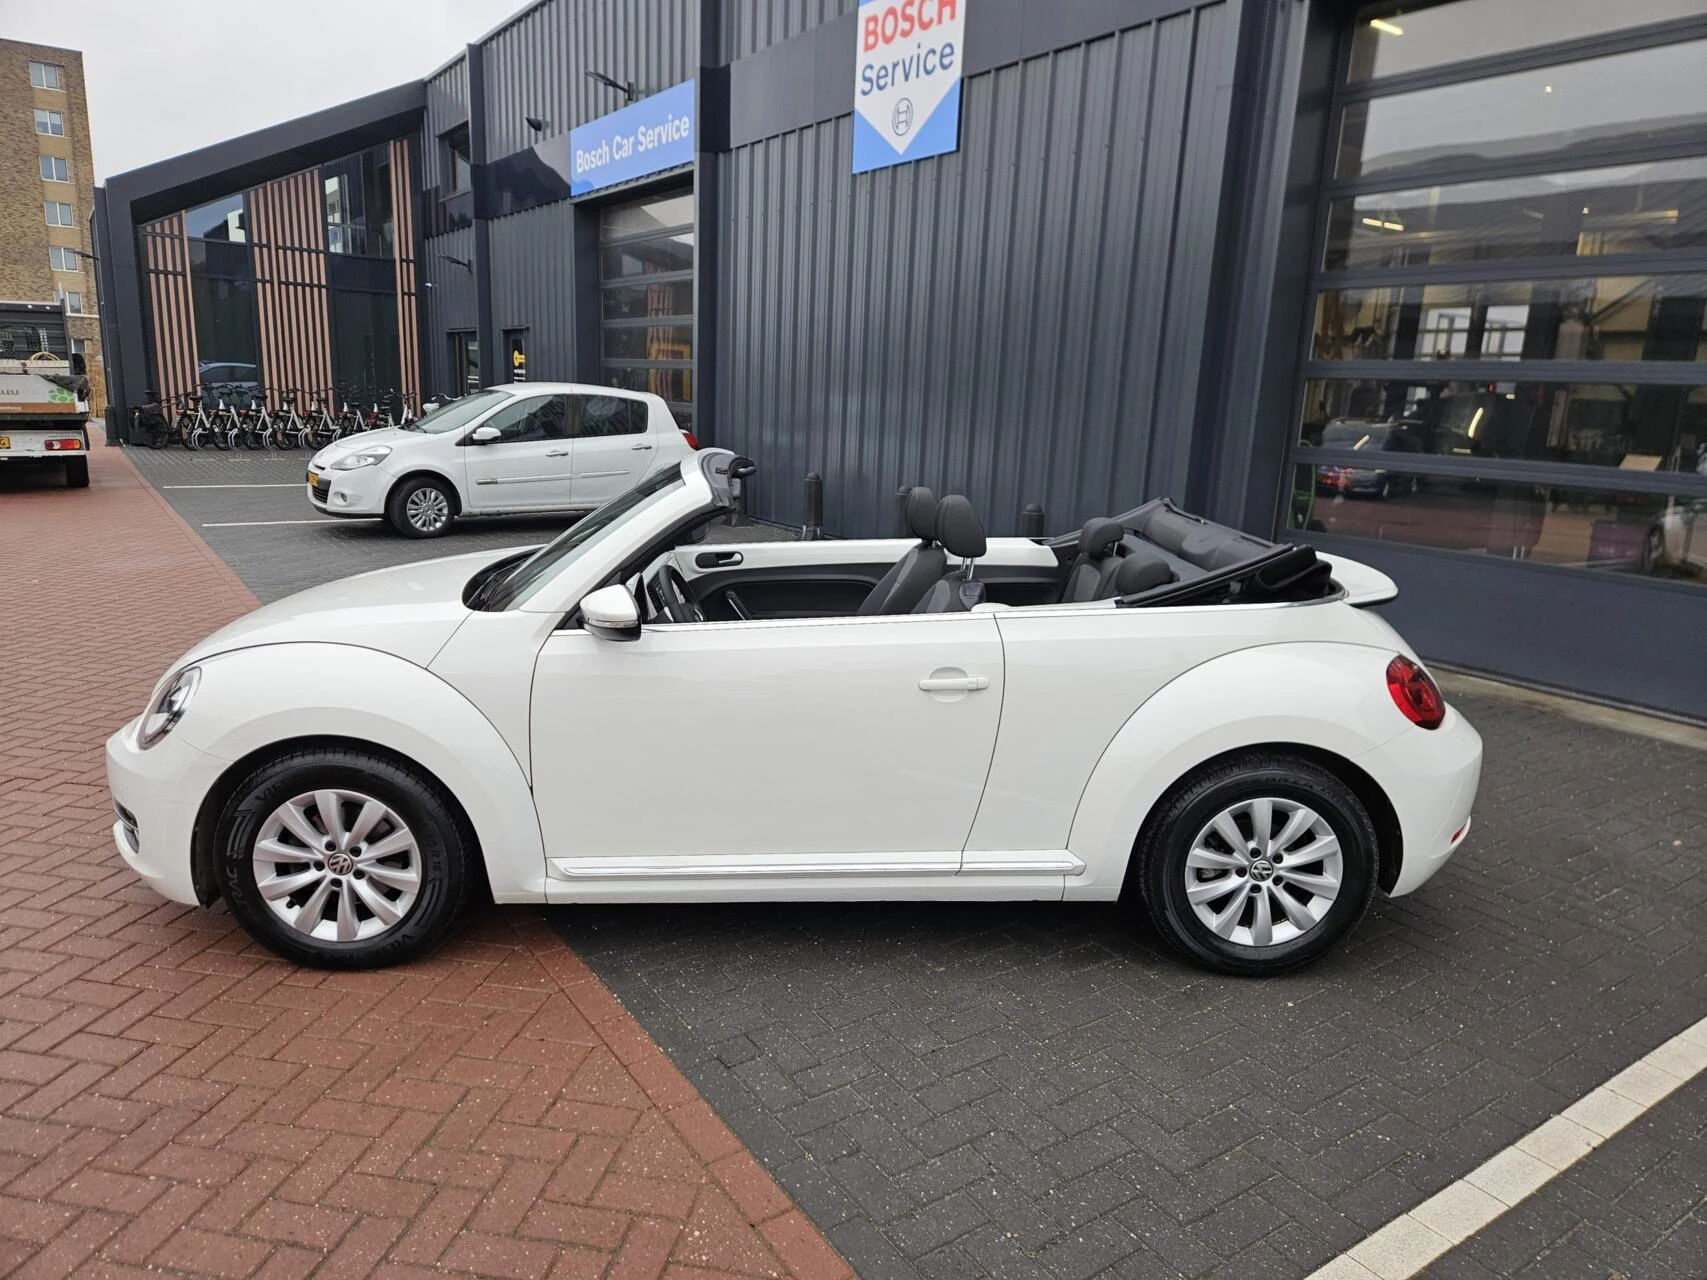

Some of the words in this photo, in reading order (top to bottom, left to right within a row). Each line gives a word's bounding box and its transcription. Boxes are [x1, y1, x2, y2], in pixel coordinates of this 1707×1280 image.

[864, 0, 957, 53] BOSCH
[861, 42, 955, 96] Service
[576, 140, 610, 174] Bosch
[612, 135, 636, 161] Car
[637, 114, 690, 152] Service
